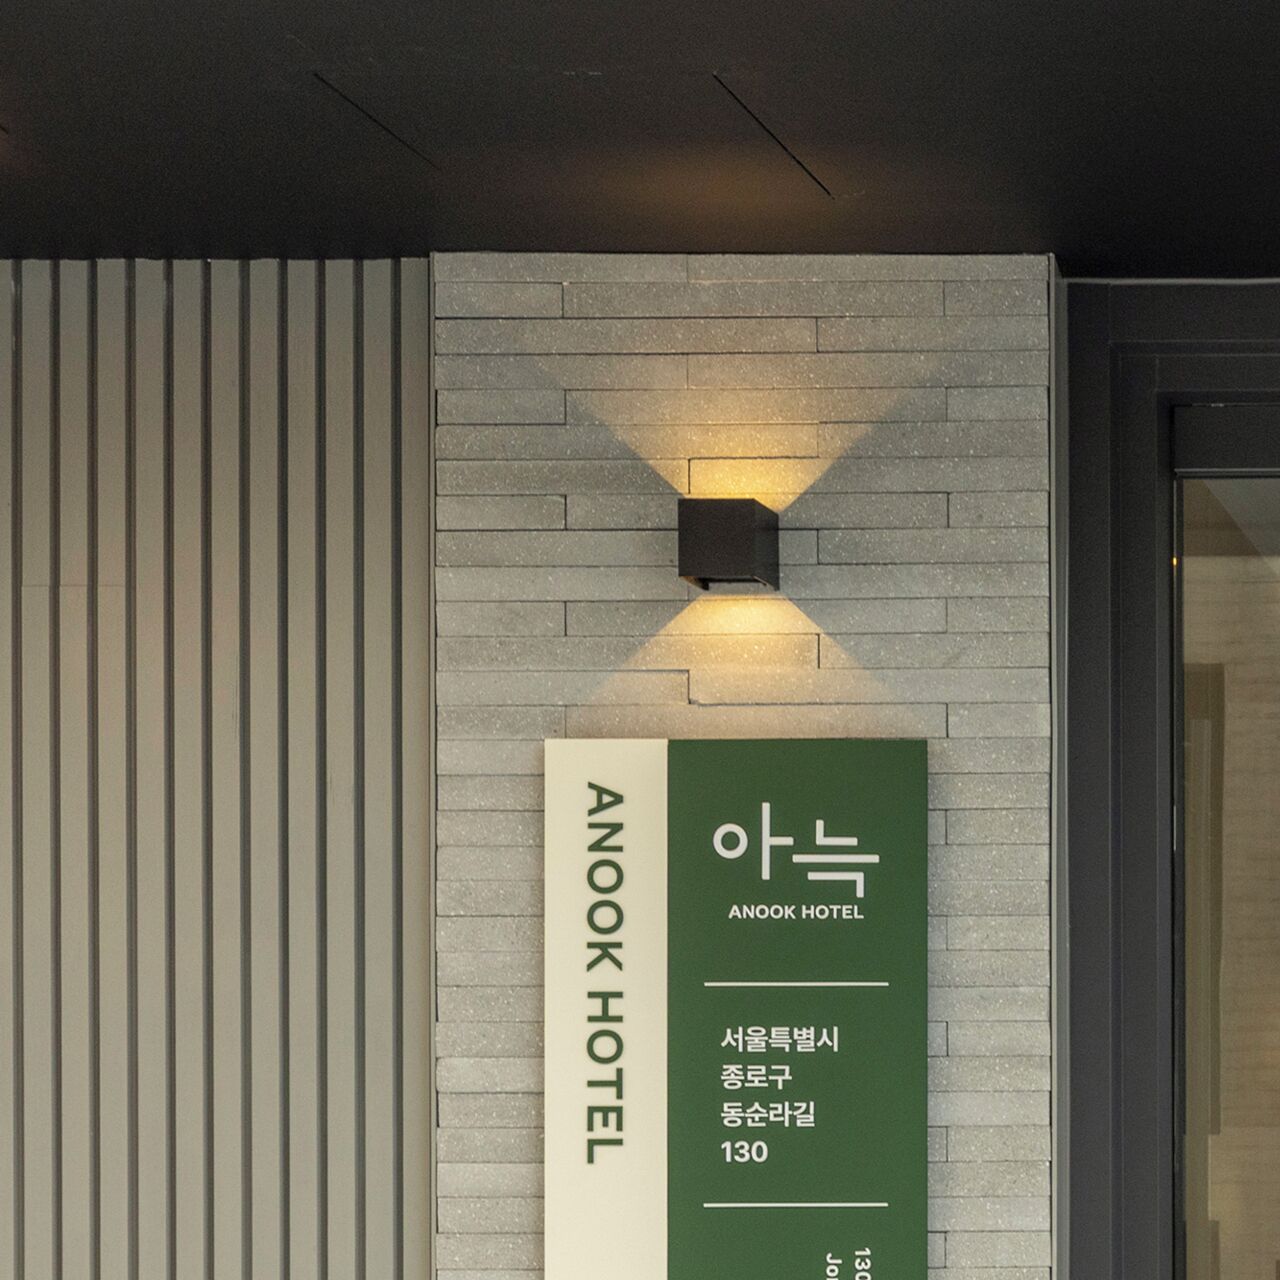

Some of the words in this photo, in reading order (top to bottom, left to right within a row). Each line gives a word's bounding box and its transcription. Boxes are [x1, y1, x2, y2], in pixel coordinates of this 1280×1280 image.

[712, 801, 880, 898] 아늑
[586, 781, 624, 972] ANOOK
[728, 904, 796, 920] ANOOK
[801, 904, 865, 920] HOTEL
[720, 1025, 840, 1053] 서울특별시
[586, 991, 624, 1165] HOTEL
[720, 1063, 793, 1090] 종로구
[720, 1100, 816, 1128] 동순라길
[720, 1140, 769, 1163] 130
